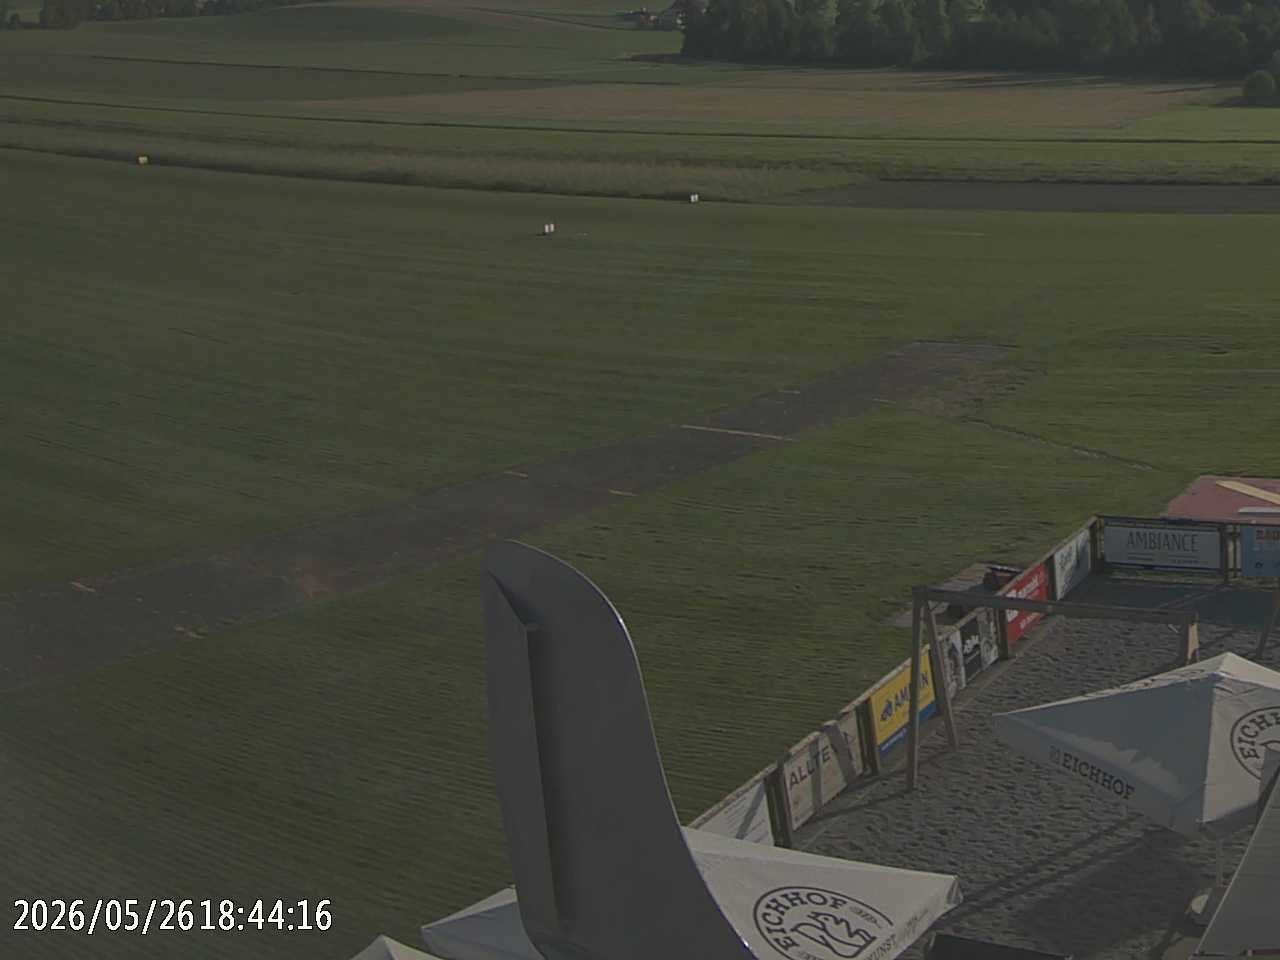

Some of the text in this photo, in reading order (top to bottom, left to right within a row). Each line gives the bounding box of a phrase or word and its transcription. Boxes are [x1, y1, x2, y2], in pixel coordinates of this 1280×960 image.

[1127, 531, 1199, 552] AMBIANCE
[1062, 751, 1136, 801] EICHHOF
[761, 892, 848, 952] EICHHOF
